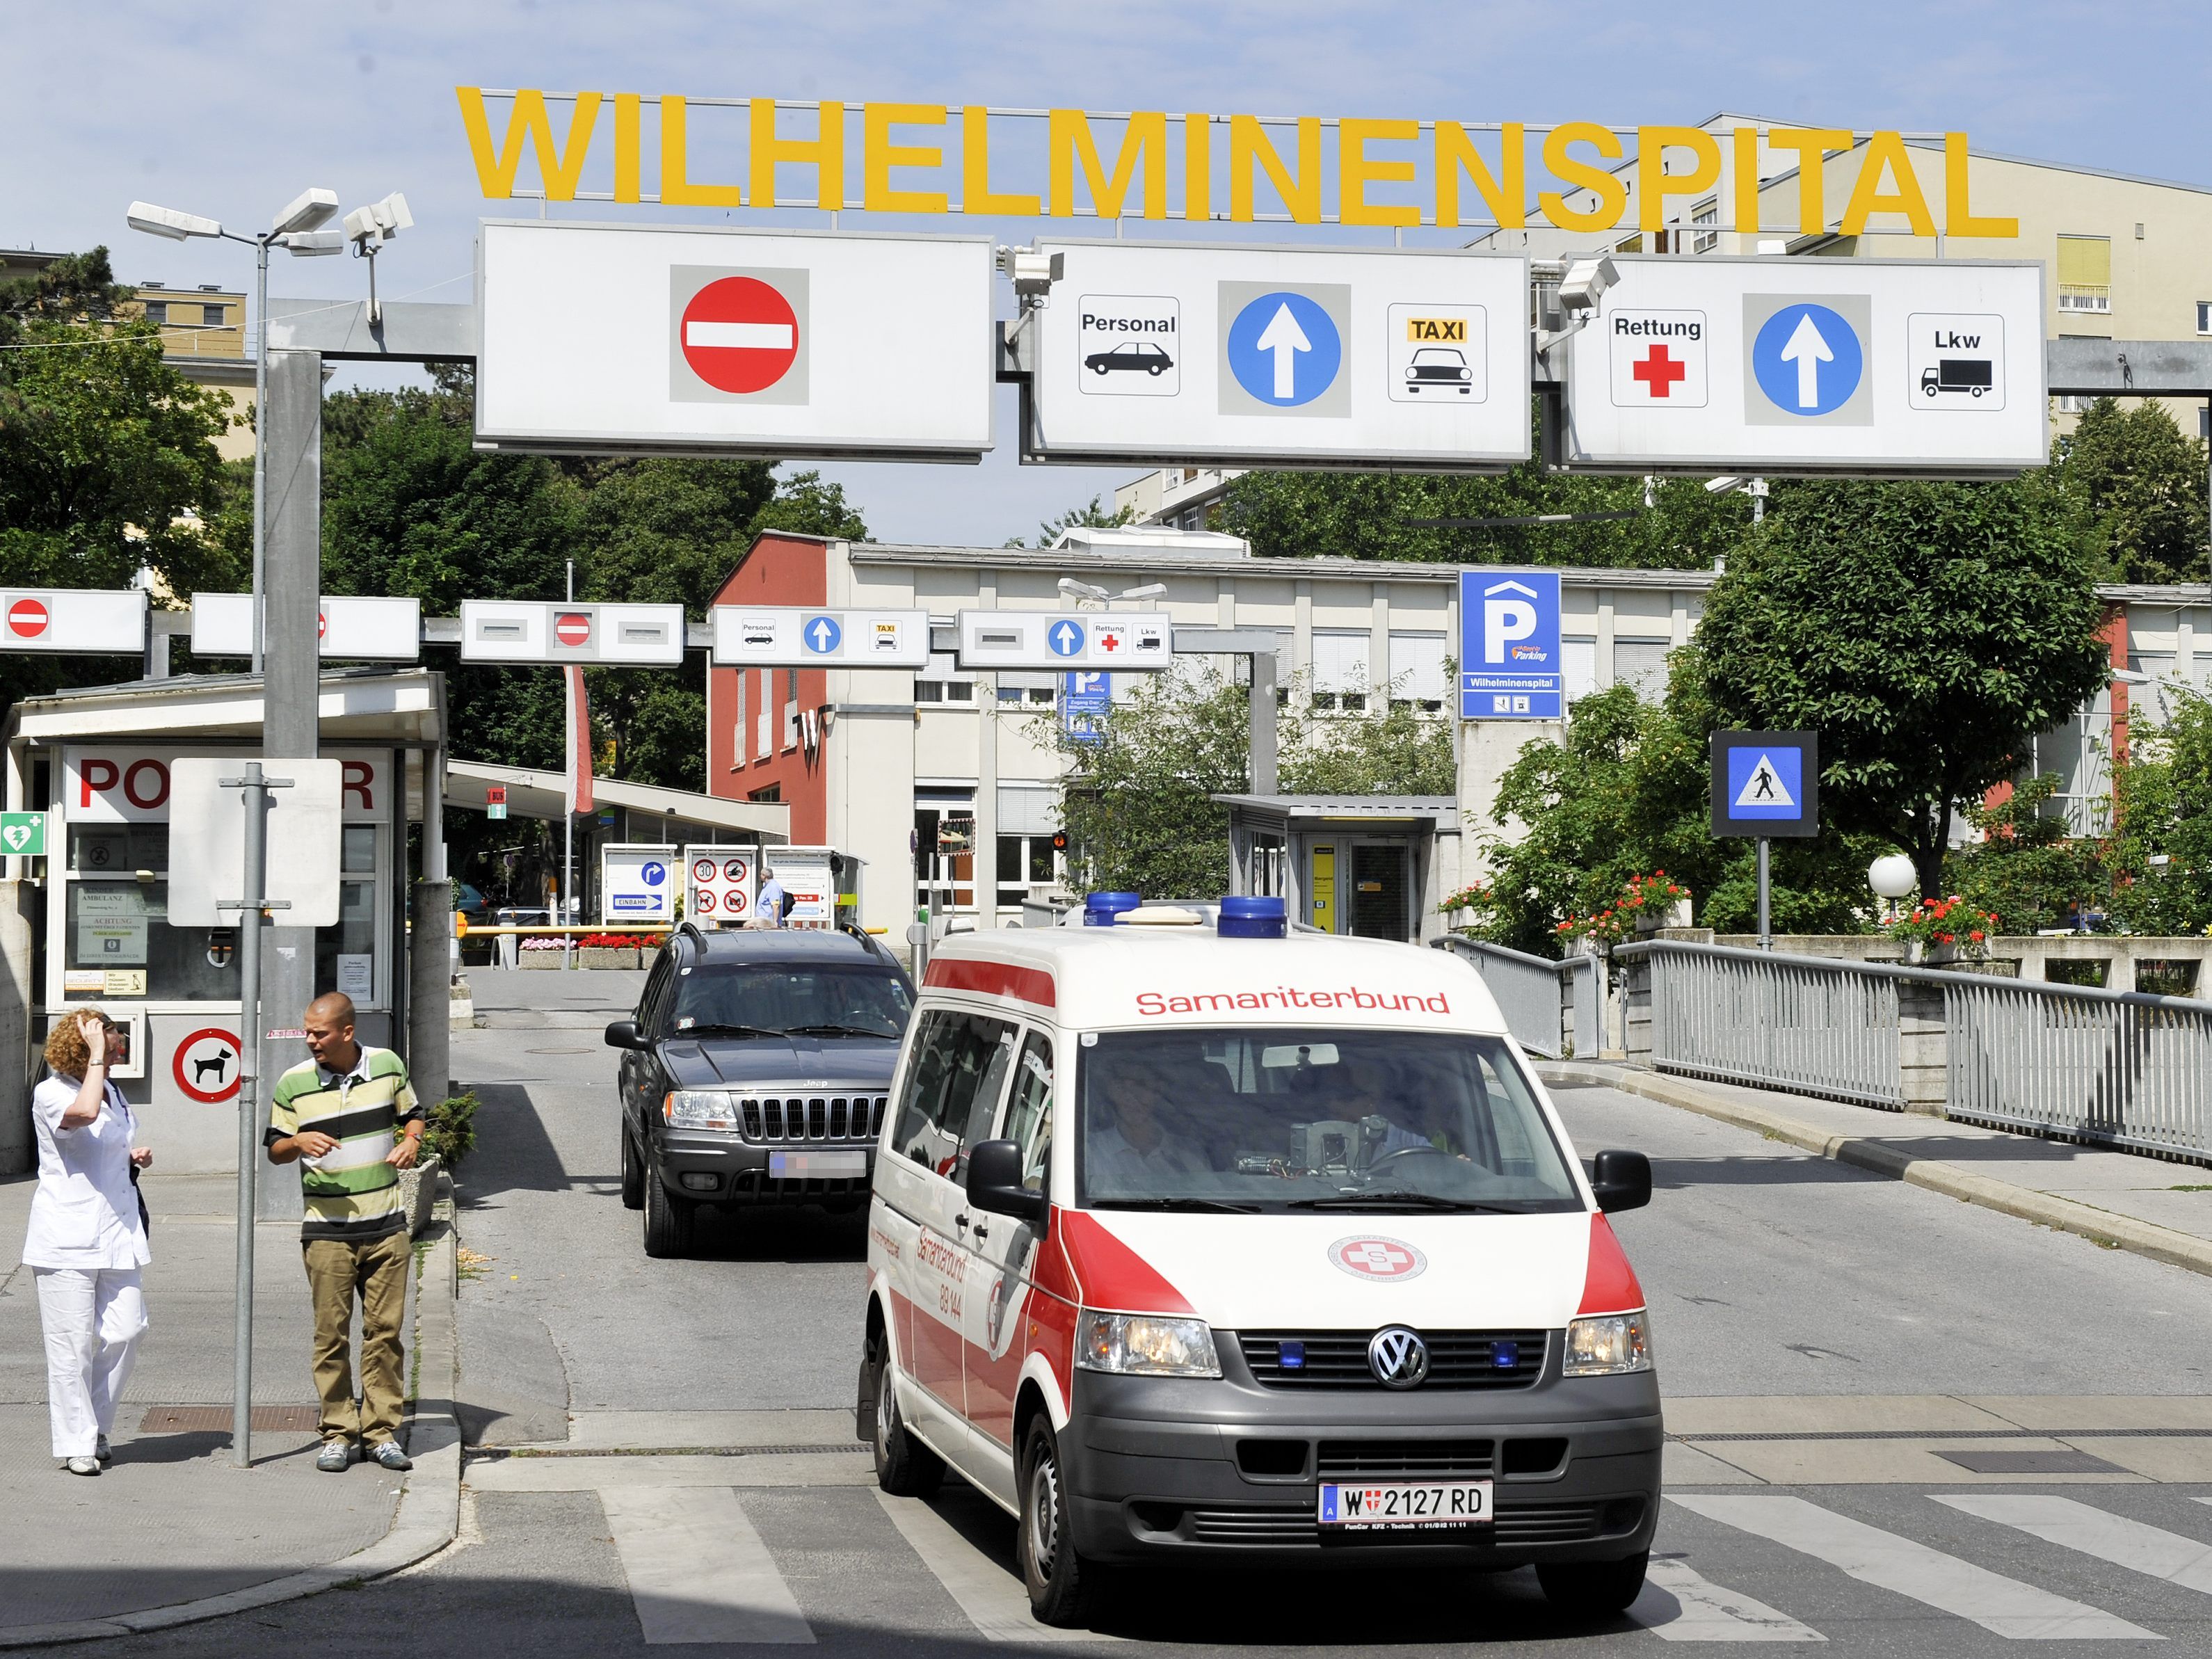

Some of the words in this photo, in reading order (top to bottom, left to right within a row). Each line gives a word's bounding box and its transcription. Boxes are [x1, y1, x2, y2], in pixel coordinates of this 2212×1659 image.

[455, 86, 2019, 238] WILHELMINENSPITAL
[1082, 313, 1176, 333] Personal
[1411, 320, 1464, 341] TAXI
[1615, 317, 1701, 339] Rettung
[1934, 330, 1981, 349] Lkw
[1095, 624, 1124, 634] Rettung
[1484, 600, 1537, 664] P
[1515, 651, 1548, 662] Parking
[1470, 678, 1553, 689] Wilhelminenspital
[492, 792, 504, 801] BUS
[699, 865, 711, 877] 30
[1136, 986, 1450, 1016] Samariterbund
[803, 1079, 828, 1088] Jeep
[917, 1228, 968, 1285] Samariterbund
[1368, 1251, 1388, 1264] S
[939, 1283, 949, 1313] 89
[949, 1292, 962, 1322] 144
[1384, 1489, 1444, 1515] 2127
[1451, 1489, 1482, 1514] RD
